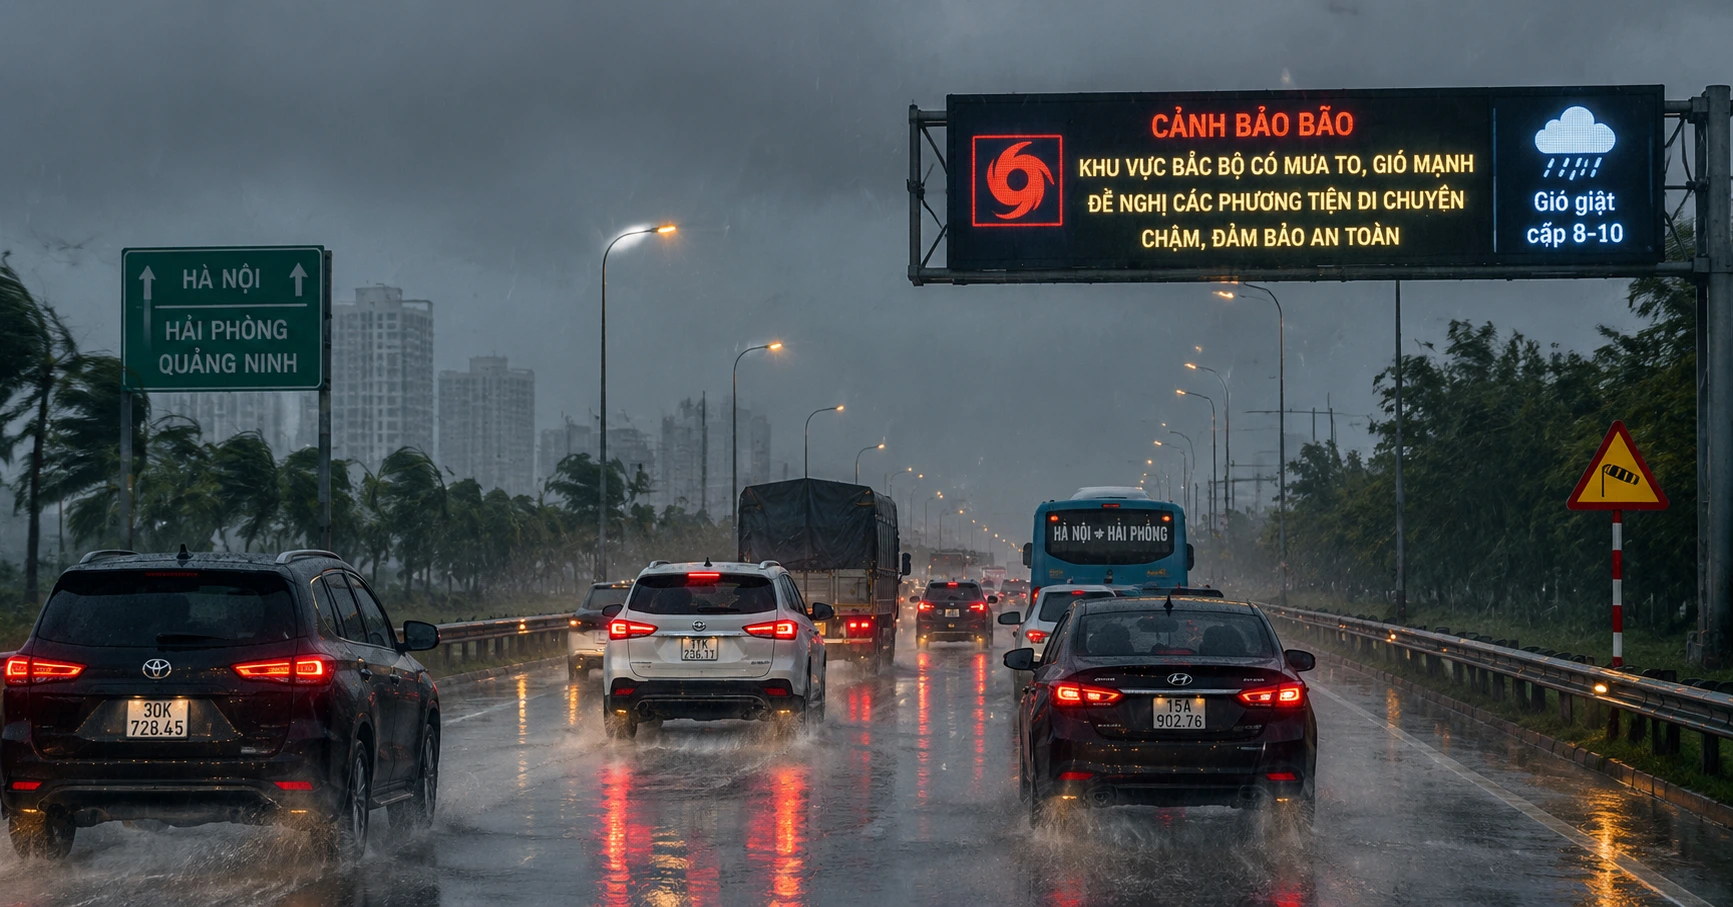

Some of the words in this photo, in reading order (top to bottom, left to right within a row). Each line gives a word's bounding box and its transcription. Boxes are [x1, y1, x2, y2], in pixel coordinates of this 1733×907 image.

[1152, 106, 1226, 138] CẢNH
[1235, 105, 1290, 138] BẢO
[1299, 105, 1354, 137] BÃO
[1079, 158, 1120, 177] KHU
[1125, 156, 1166, 181] VỰC
[1218, 151, 1245, 180] BỘ
[1251, 151, 1278, 175] CÓ
[1284, 154, 1330, 175] MƯA
[1335, 155, 1367, 178] TO,
[1373, 150, 1407, 174] GIÓ
[1413, 154, 1474, 178] MẠNH
[1119, 193, 1167, 216] NGHỊ
[1173, 188, 1213, 212] CÁC
[1218, 191, 1302, 212] PHƯƠNG
[1307, 187, 1351, 215] TIỆN
[1534, 190, 1569, 212] Gió
[1575, 190, 1615, 216] giật
[1142, 224, 1206, 252] CHẬM,
[1211, 223, 1257, 247] ĐẢM
[1264, 222, 1305, 247] BẢO
[1310, 227, 1339, 246] AN
[1345, 222, 1400, 246] TOÀN
[1573, 223, 1624, 243] 8-10
[183, 263, 213, 289] HÀ
[222, 263, 260, 294] NỘI
[165, 314, 203, 340] HẢI
[211, 314, 288, 340] PHÒNG
[159, 347, 236, 375] QUẢNG
[245, 353, 297, 373] NINH
[144, 702, 172, 718] 30K
[1167, 699, 1192, 713] 15A
[131, 720, 184, 736] 728.45
[1156, 714, 1203, 728] 902.76
